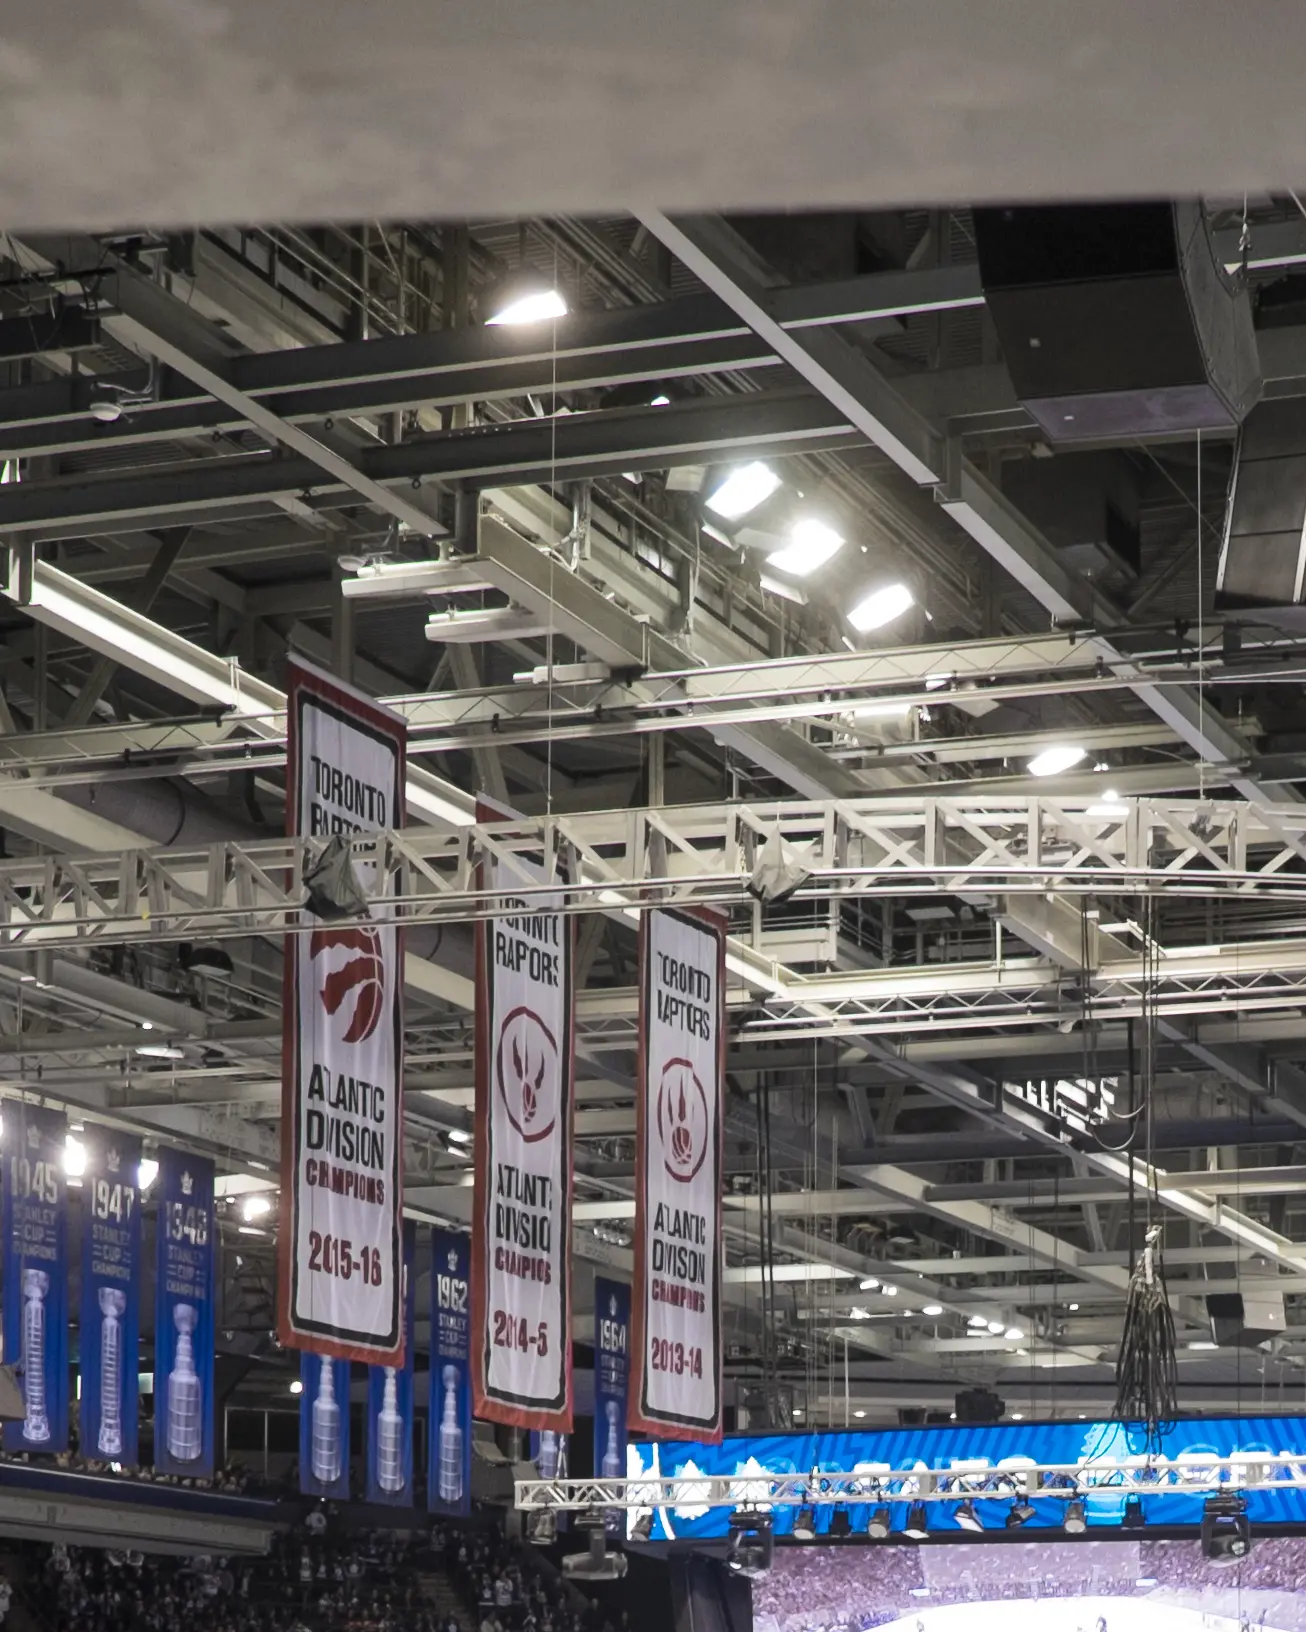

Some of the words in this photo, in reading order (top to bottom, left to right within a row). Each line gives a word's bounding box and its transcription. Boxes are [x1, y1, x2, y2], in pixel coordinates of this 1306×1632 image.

[311, 755, 386, 828] TORONTO
[10, 1155, 58, 1205] 1945
[91, 1176, 135, 1224] 1947
[308, 1230, 383, 1287] 2015-16
[436, 1273, 468, 1314] 1962
[651, 1336, 703, 1380] 2013-14
